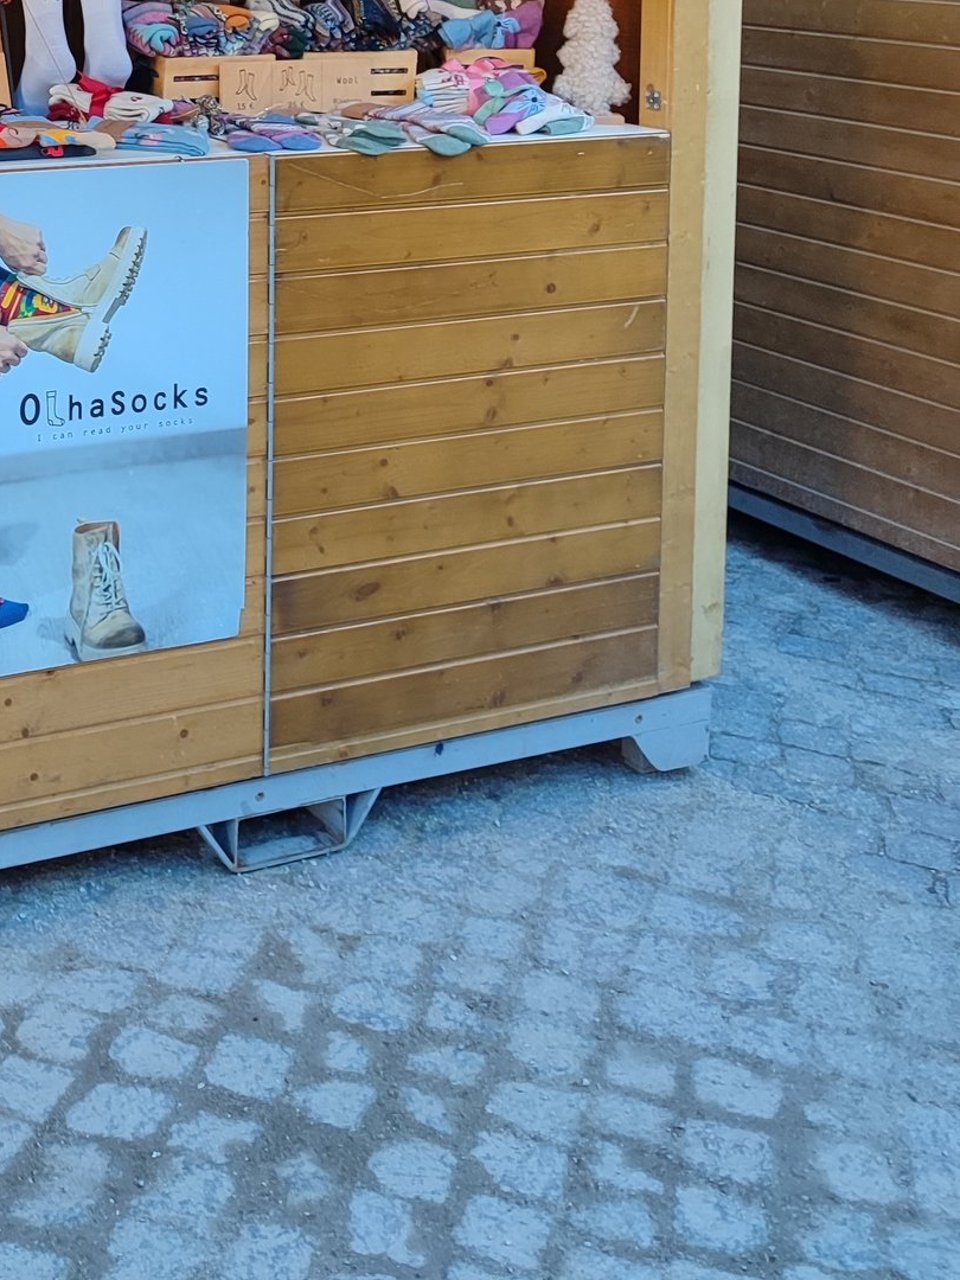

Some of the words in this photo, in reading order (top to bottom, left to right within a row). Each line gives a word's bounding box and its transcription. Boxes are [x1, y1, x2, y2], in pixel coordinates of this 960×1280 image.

[336, 76, 358, 85] Wool
[237, 102, 246, 110] 15
[52, 431, 73, 440] can
[83, 426, 111, 436] read
[120, 422, 149, 433] your
[158, 418, 193, 427] socks
